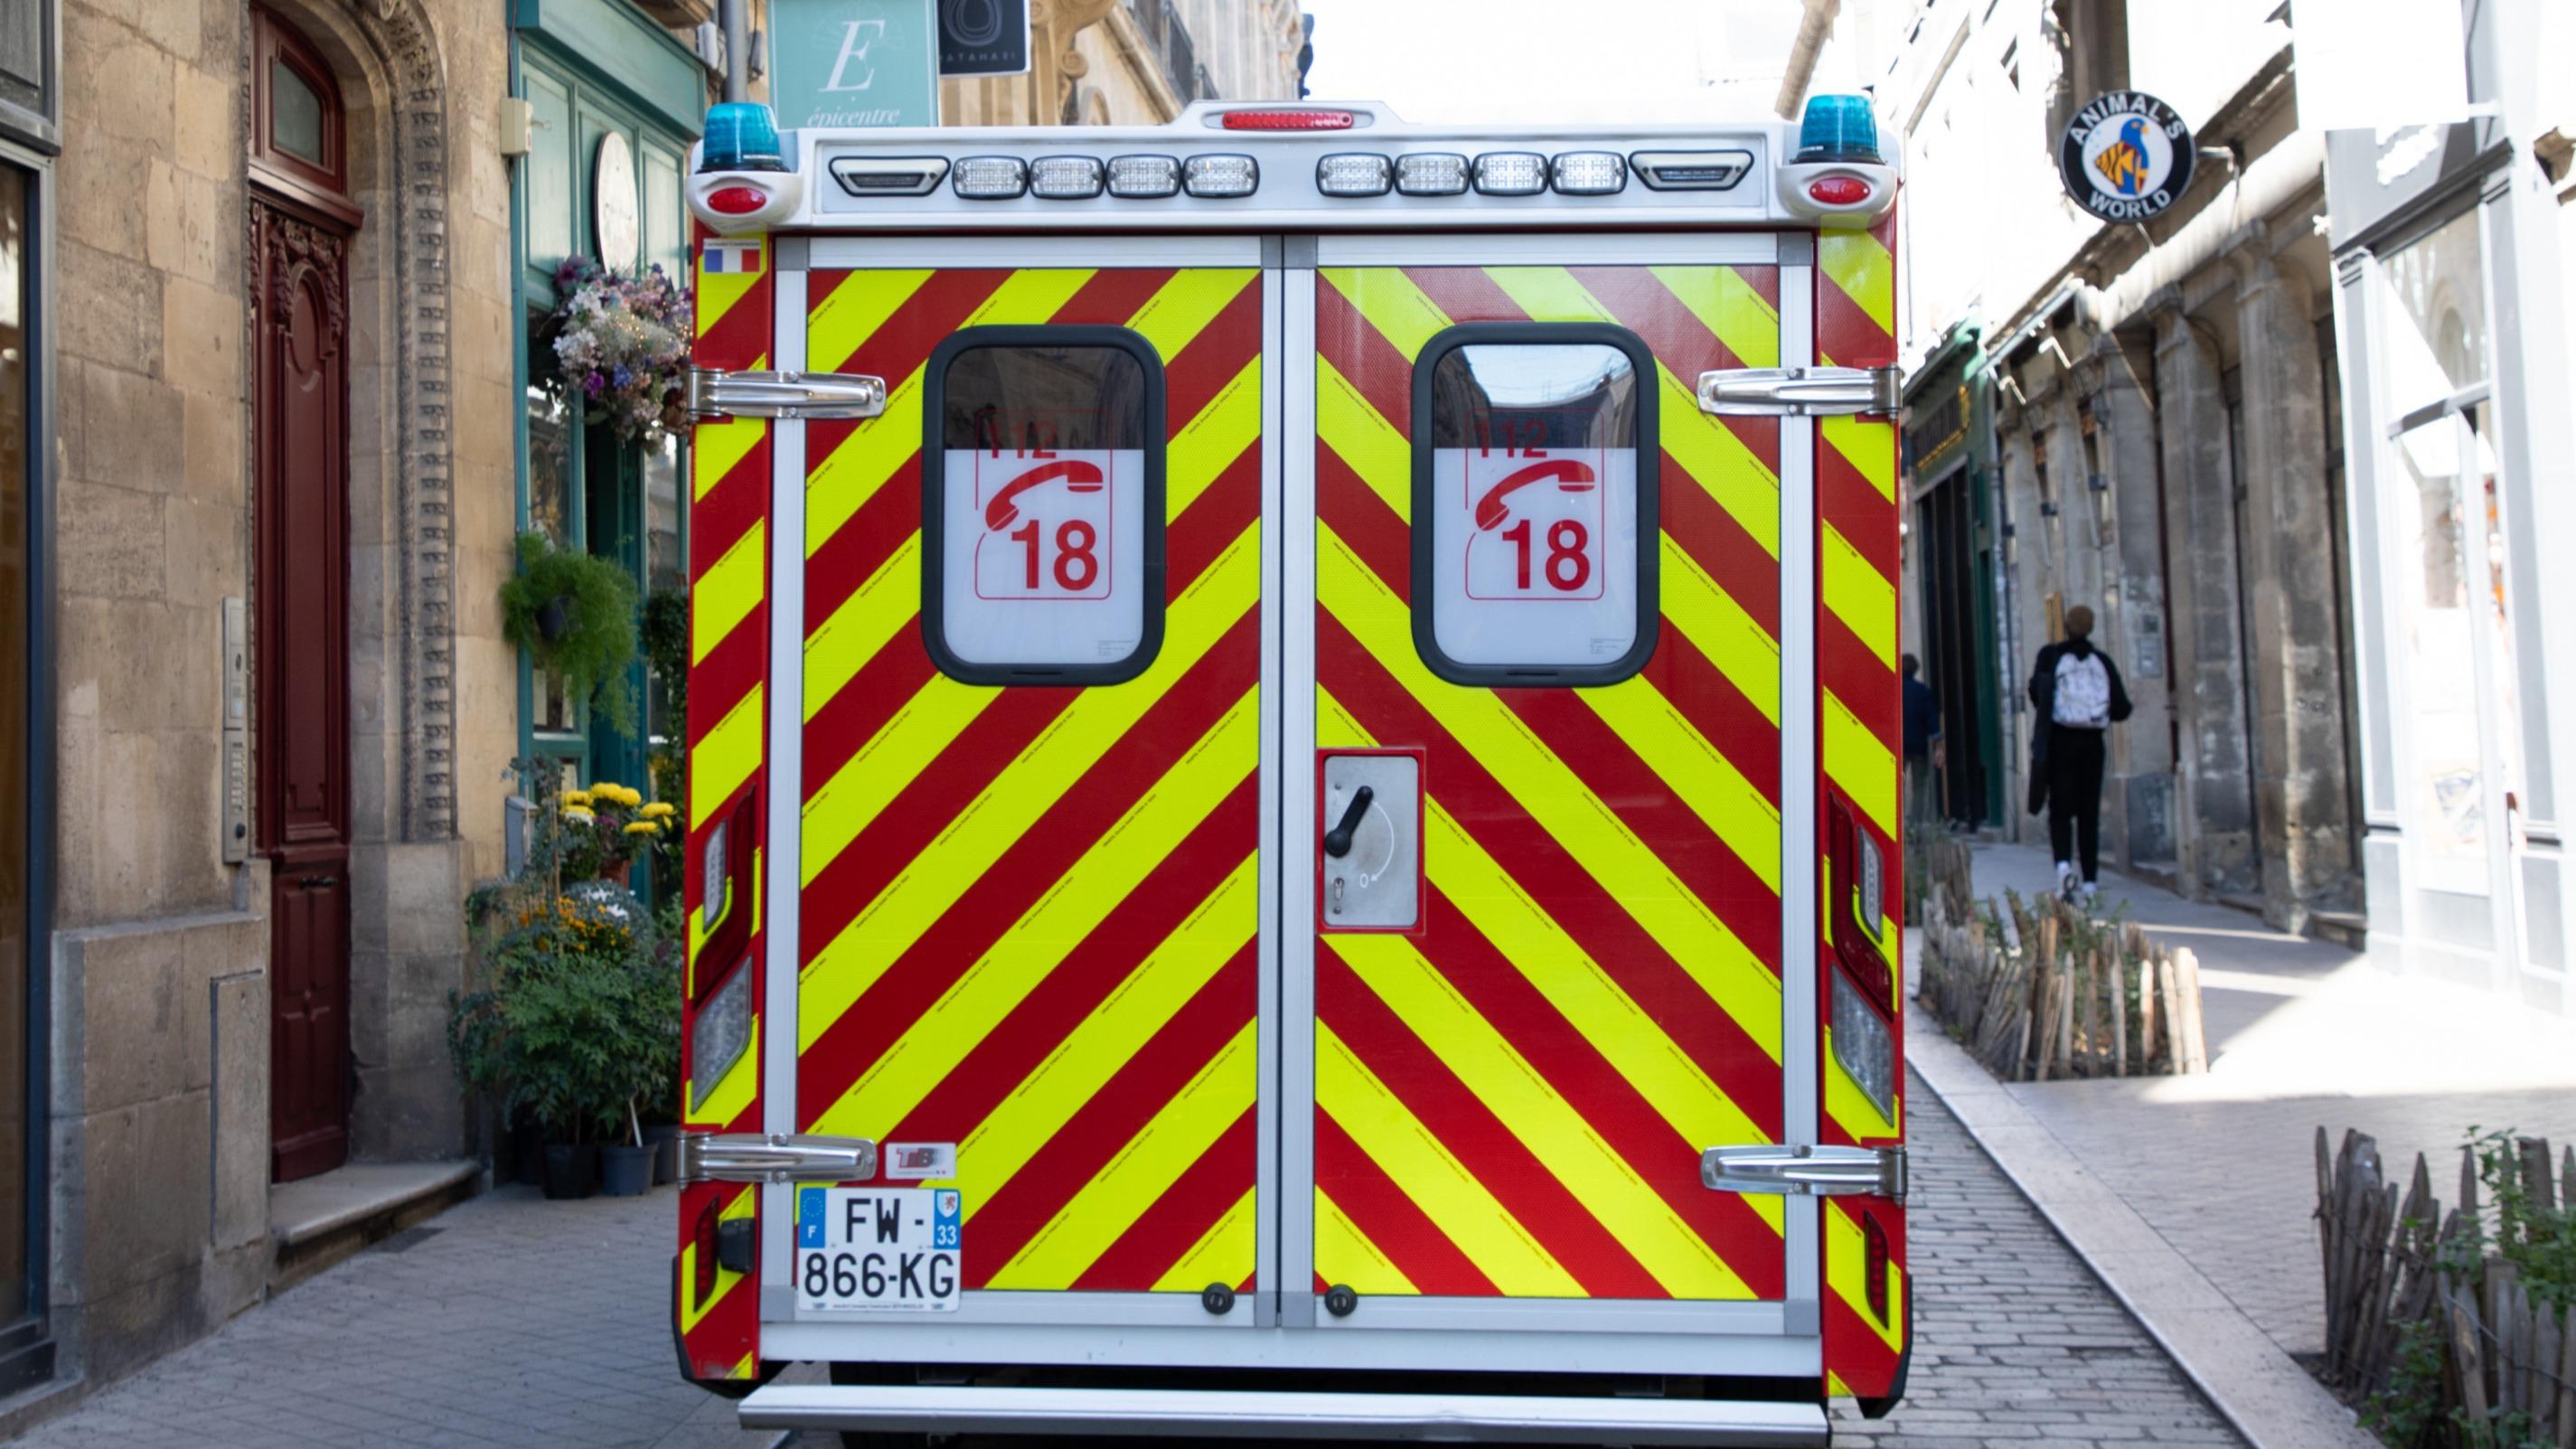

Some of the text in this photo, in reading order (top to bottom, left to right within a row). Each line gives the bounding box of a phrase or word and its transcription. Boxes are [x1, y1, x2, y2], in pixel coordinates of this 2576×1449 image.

[939, 51, 1016, 63] ATAHARI
[807, 106, 900, 127] épicentre
[2070, 93, 2186, 146] ANIMAL'S
[2089, 189, 2171, 219] WORLD
[984, 419, 1057, 458] 112
[1474, 419, 1547, 457] 112
[1011, 519, 1098, 591] 18
[1502, 519, 1591, 591] 18
[807, 1226, 816, 1239] F
[936, 1225, 956, 1246] 33
[804, 1252, 954, 1299] 866-KG
